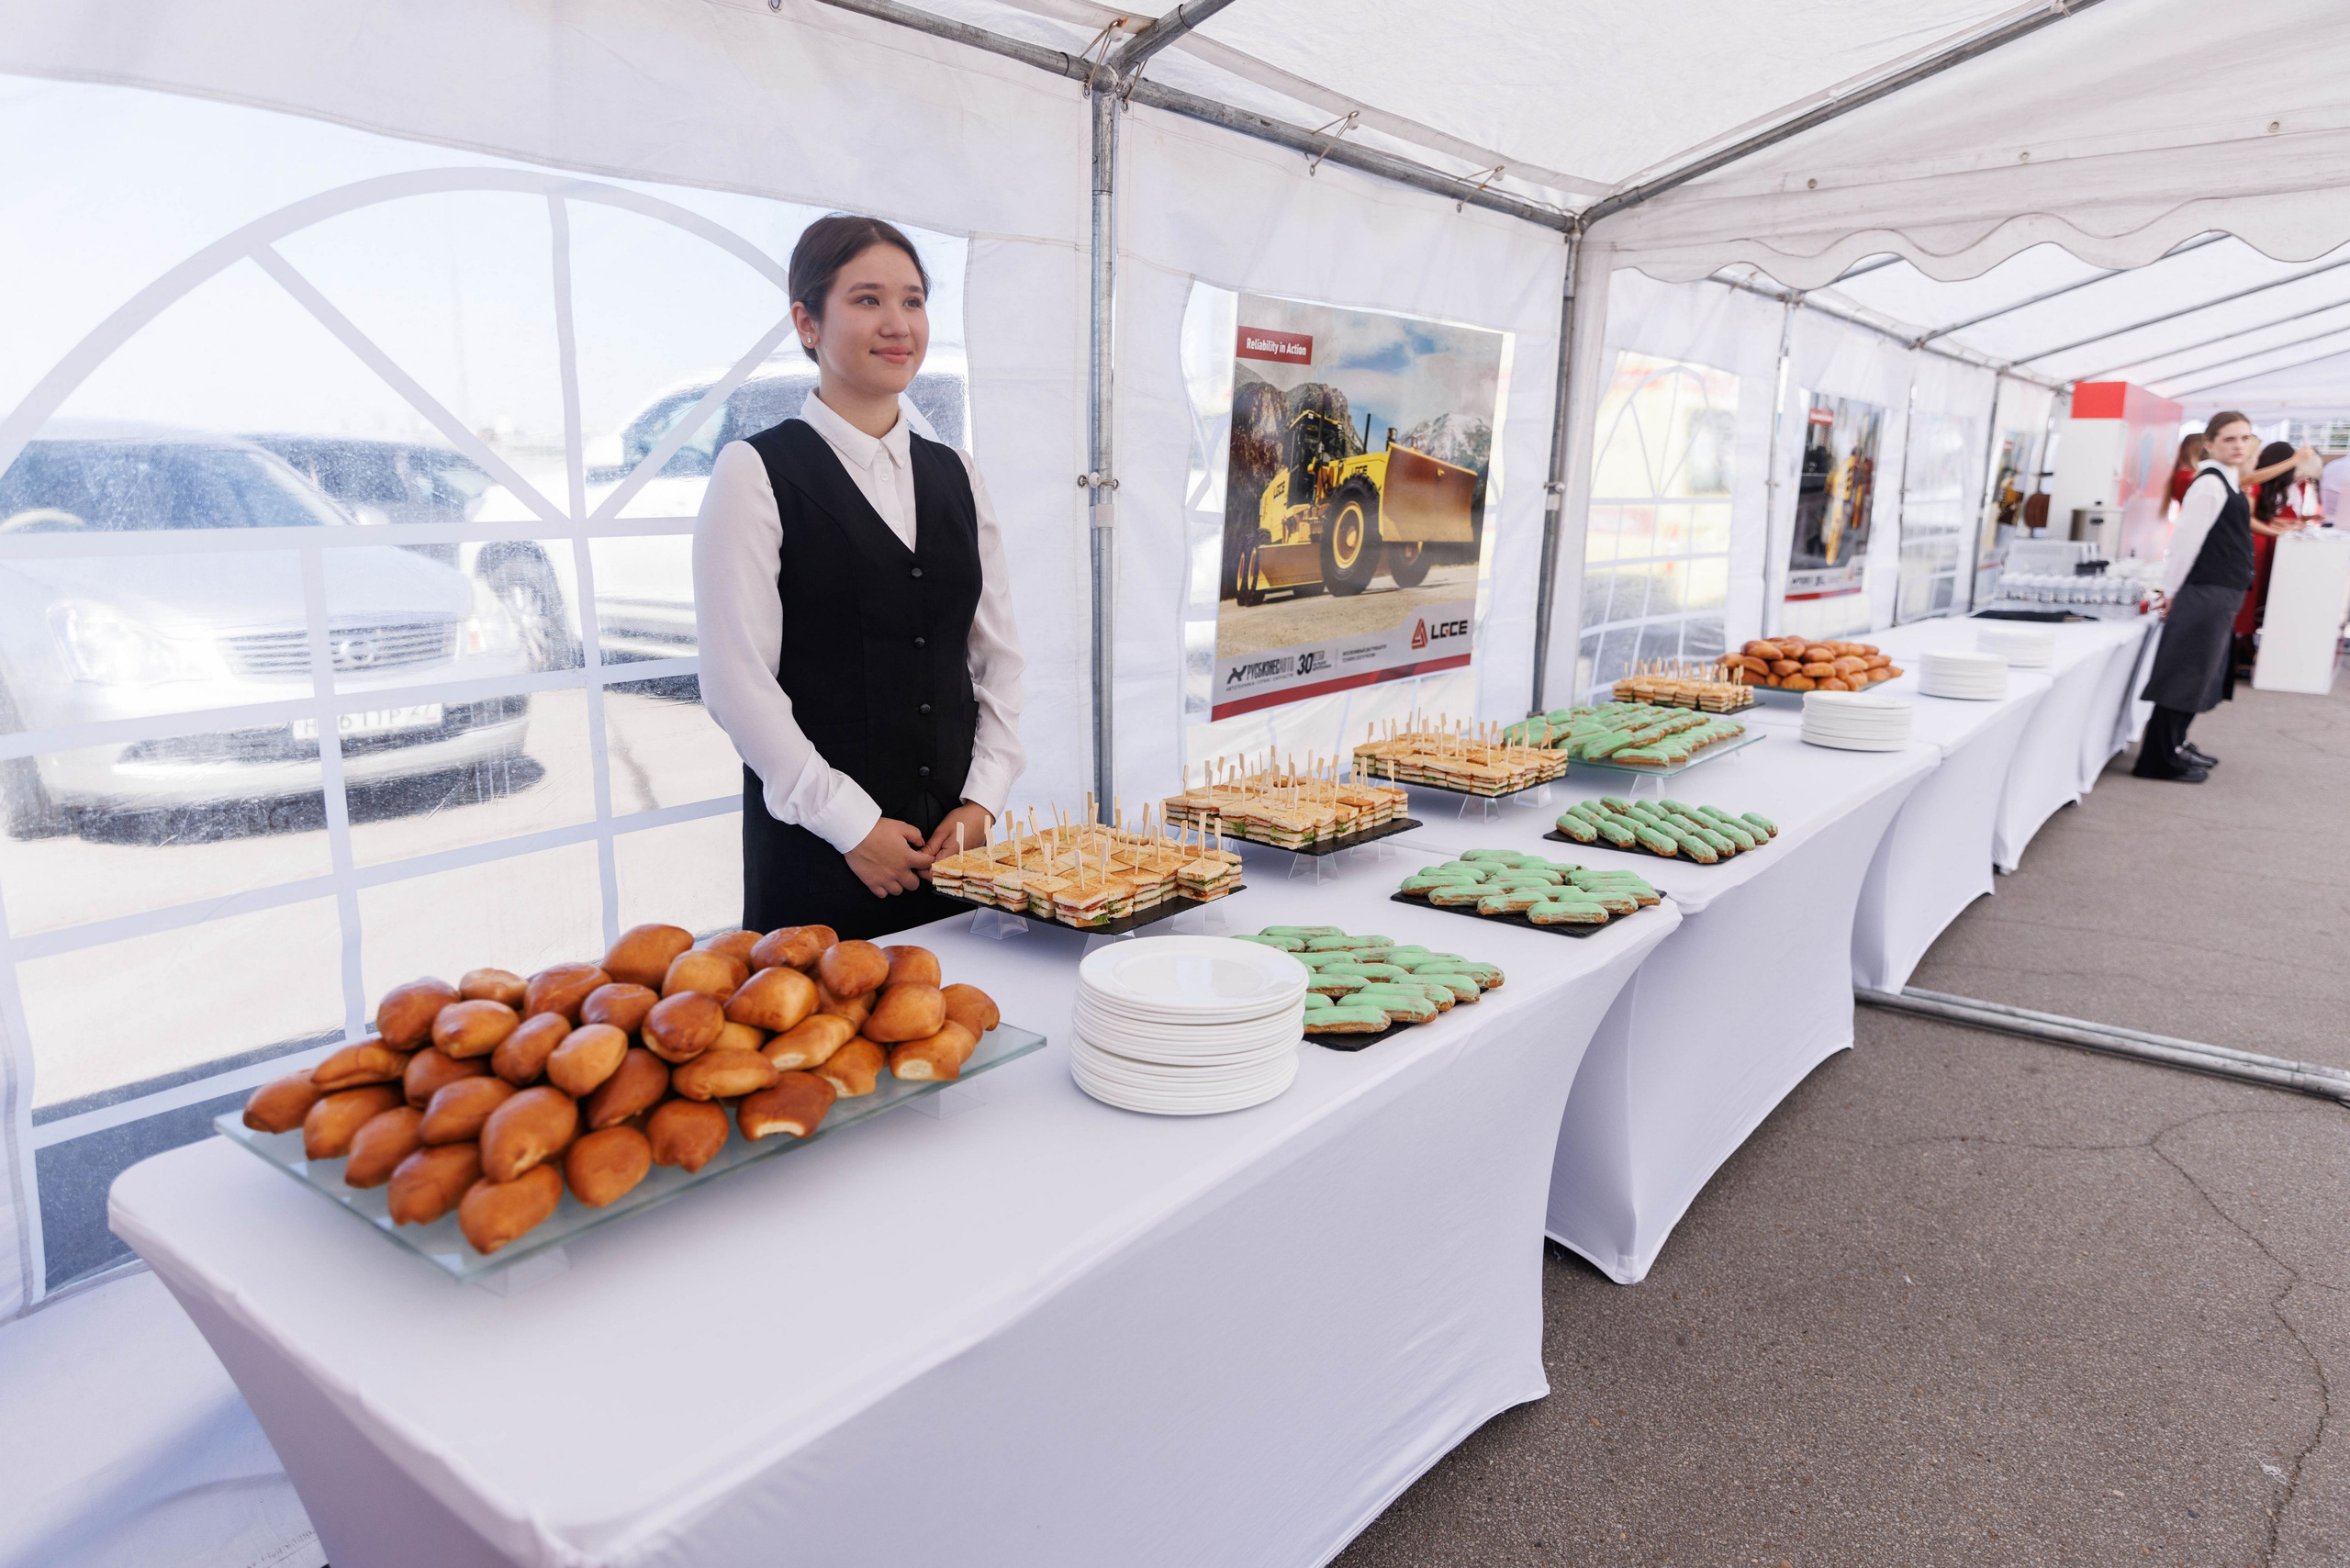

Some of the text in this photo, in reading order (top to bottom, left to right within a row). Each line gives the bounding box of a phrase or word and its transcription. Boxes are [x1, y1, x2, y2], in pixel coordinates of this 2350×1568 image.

[1246, 337, 1307, 356] Reliability in Action
[1430, 620, 1469, 641] LGCE
[1296, 652, 1315, 676] 30
